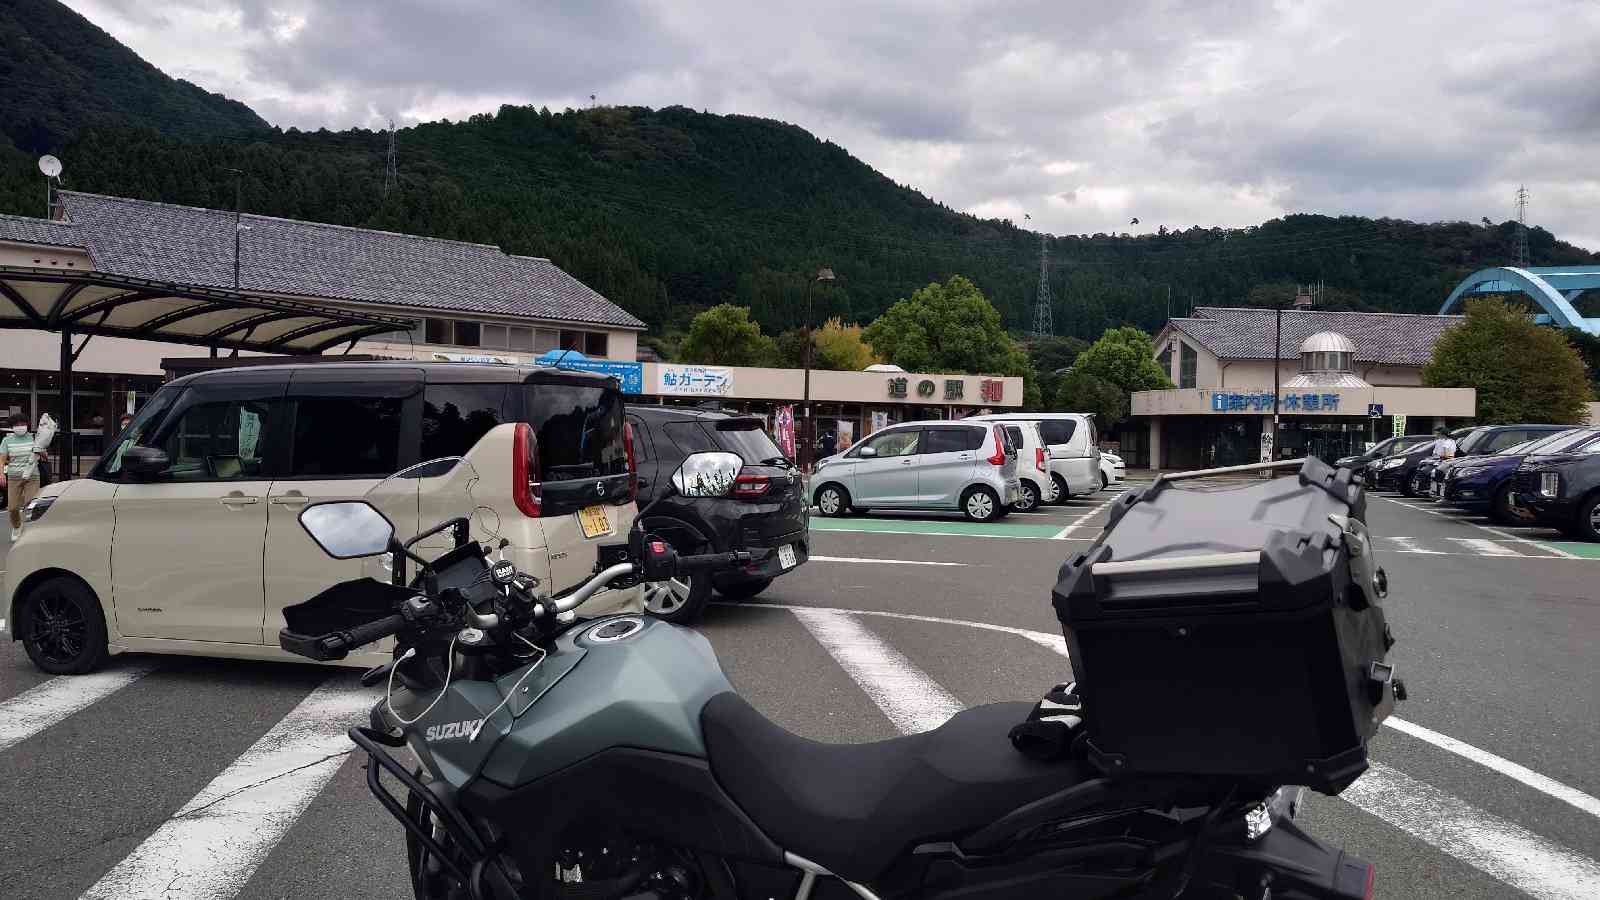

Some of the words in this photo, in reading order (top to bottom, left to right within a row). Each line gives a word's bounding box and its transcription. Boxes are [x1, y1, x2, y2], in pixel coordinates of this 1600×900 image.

[663, 372, 729, 387] 鮎ガーデン
[887, 377, 964, 400] 道の駅
